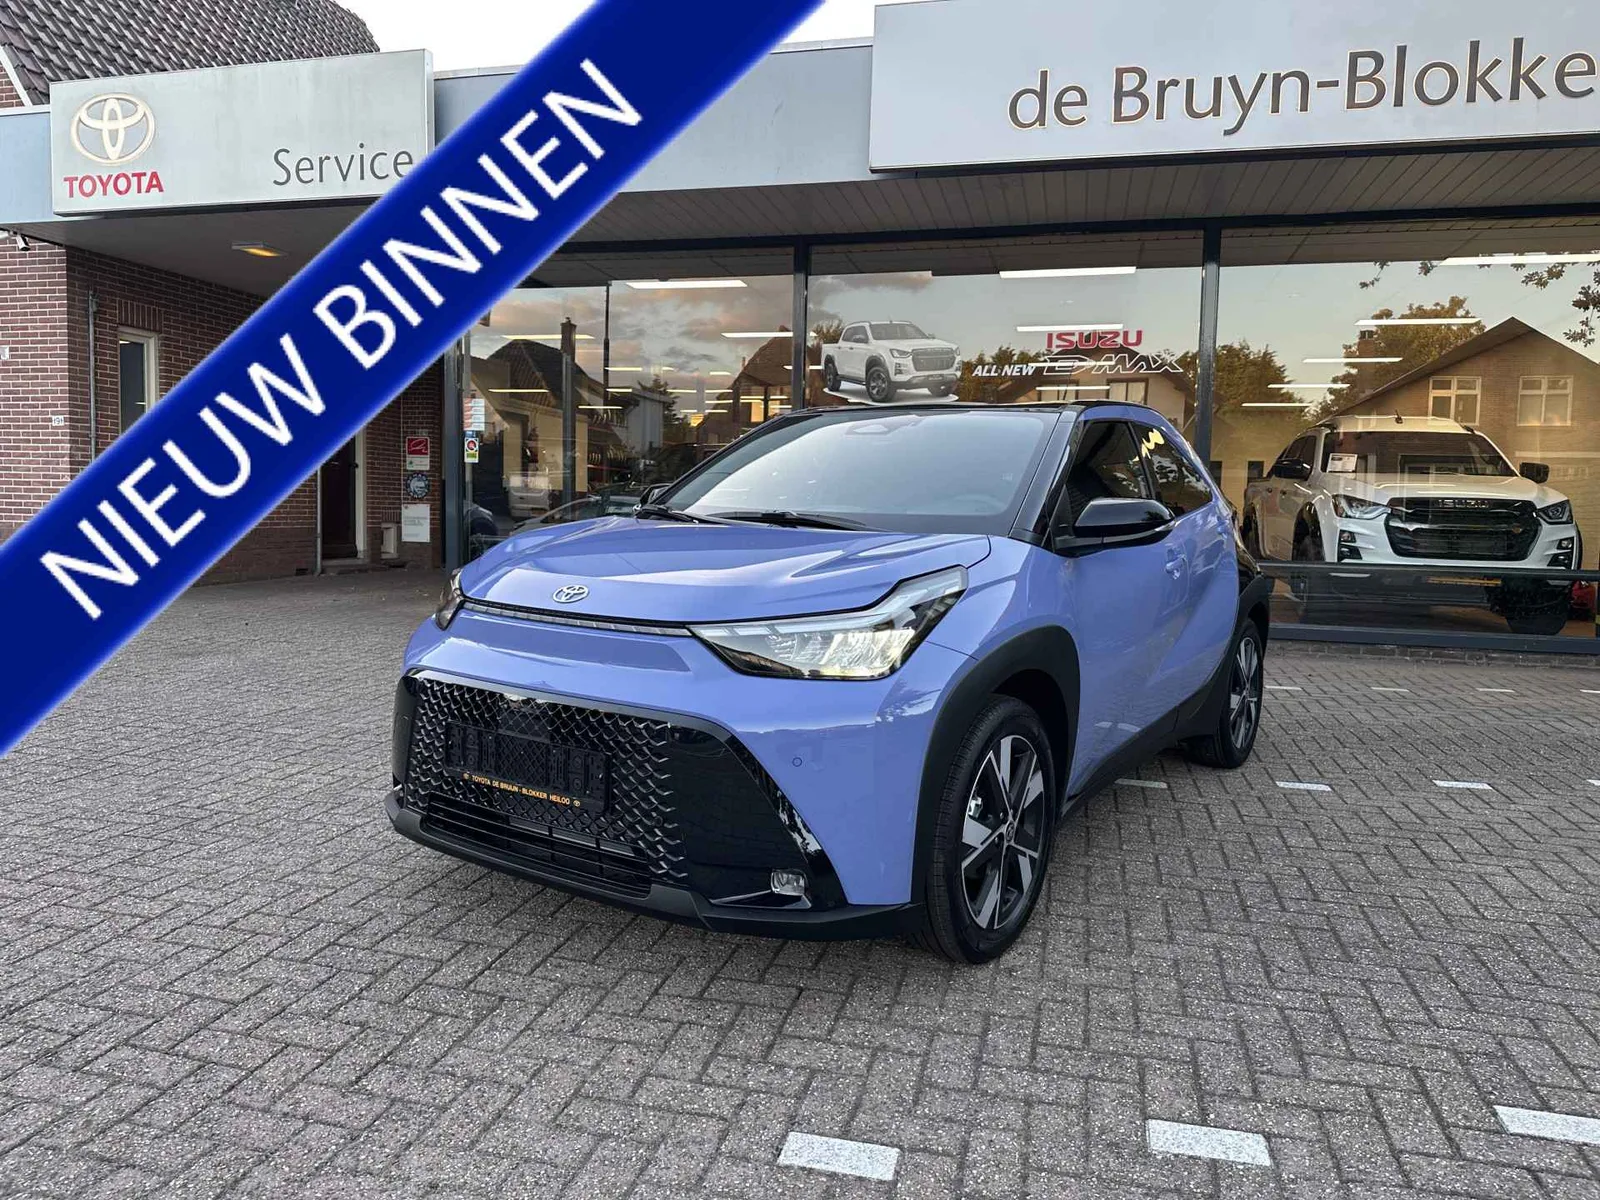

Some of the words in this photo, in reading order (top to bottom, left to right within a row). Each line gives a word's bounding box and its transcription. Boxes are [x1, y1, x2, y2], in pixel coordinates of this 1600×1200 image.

[1008, 68, 1089, 131] de
[1111, 36, 1598, 137] Bruyn-Blokke
[272, 142, 414, 187] Service
[63, 170, 165, 199] TOYOTA
[1046, 330, 1143, 349] ISUZU
[972, 364, 1001, 377] ALL
[1001, 363, 1037, 377] NEW
[1043, 353, 1184, 376] D-MAX
[471, 775, 490, 785] TOYOTA
